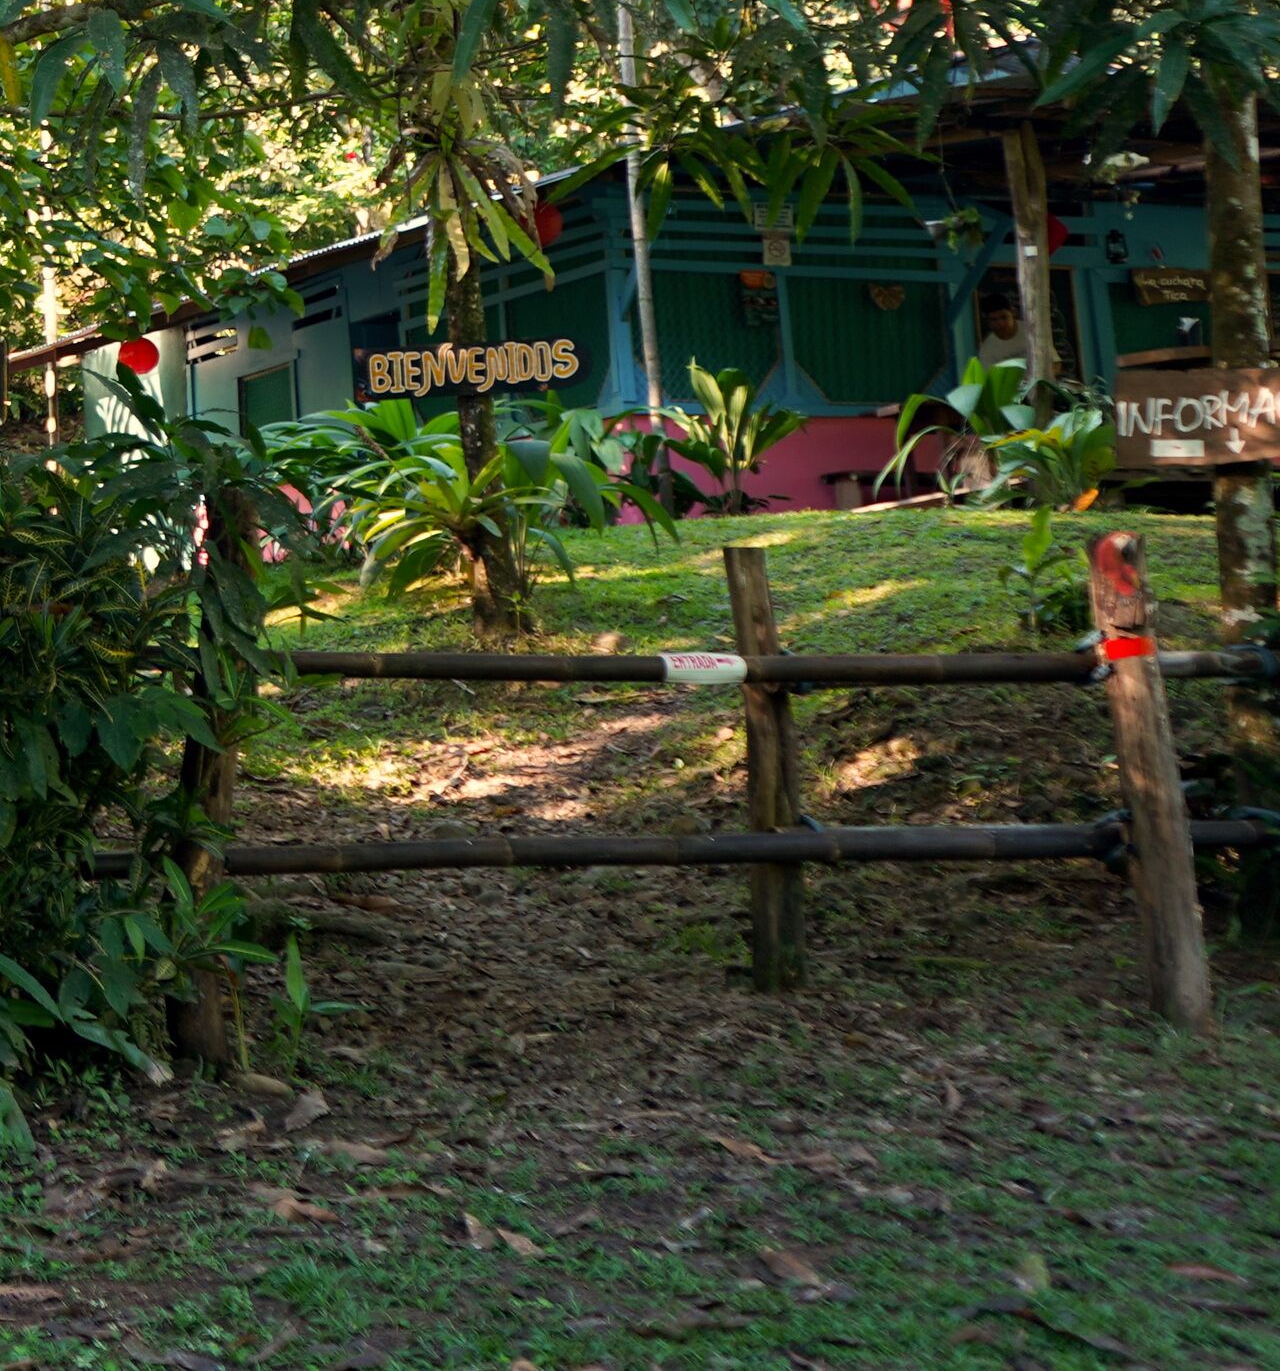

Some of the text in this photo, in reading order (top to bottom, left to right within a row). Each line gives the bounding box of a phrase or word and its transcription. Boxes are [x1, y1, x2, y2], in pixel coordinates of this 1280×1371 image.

[368, 337, 580, 398] BIENVENIDOS
[1116, 386, 1280, 437] INFORMA
[670, 655, 719, 669] ENTRADA
